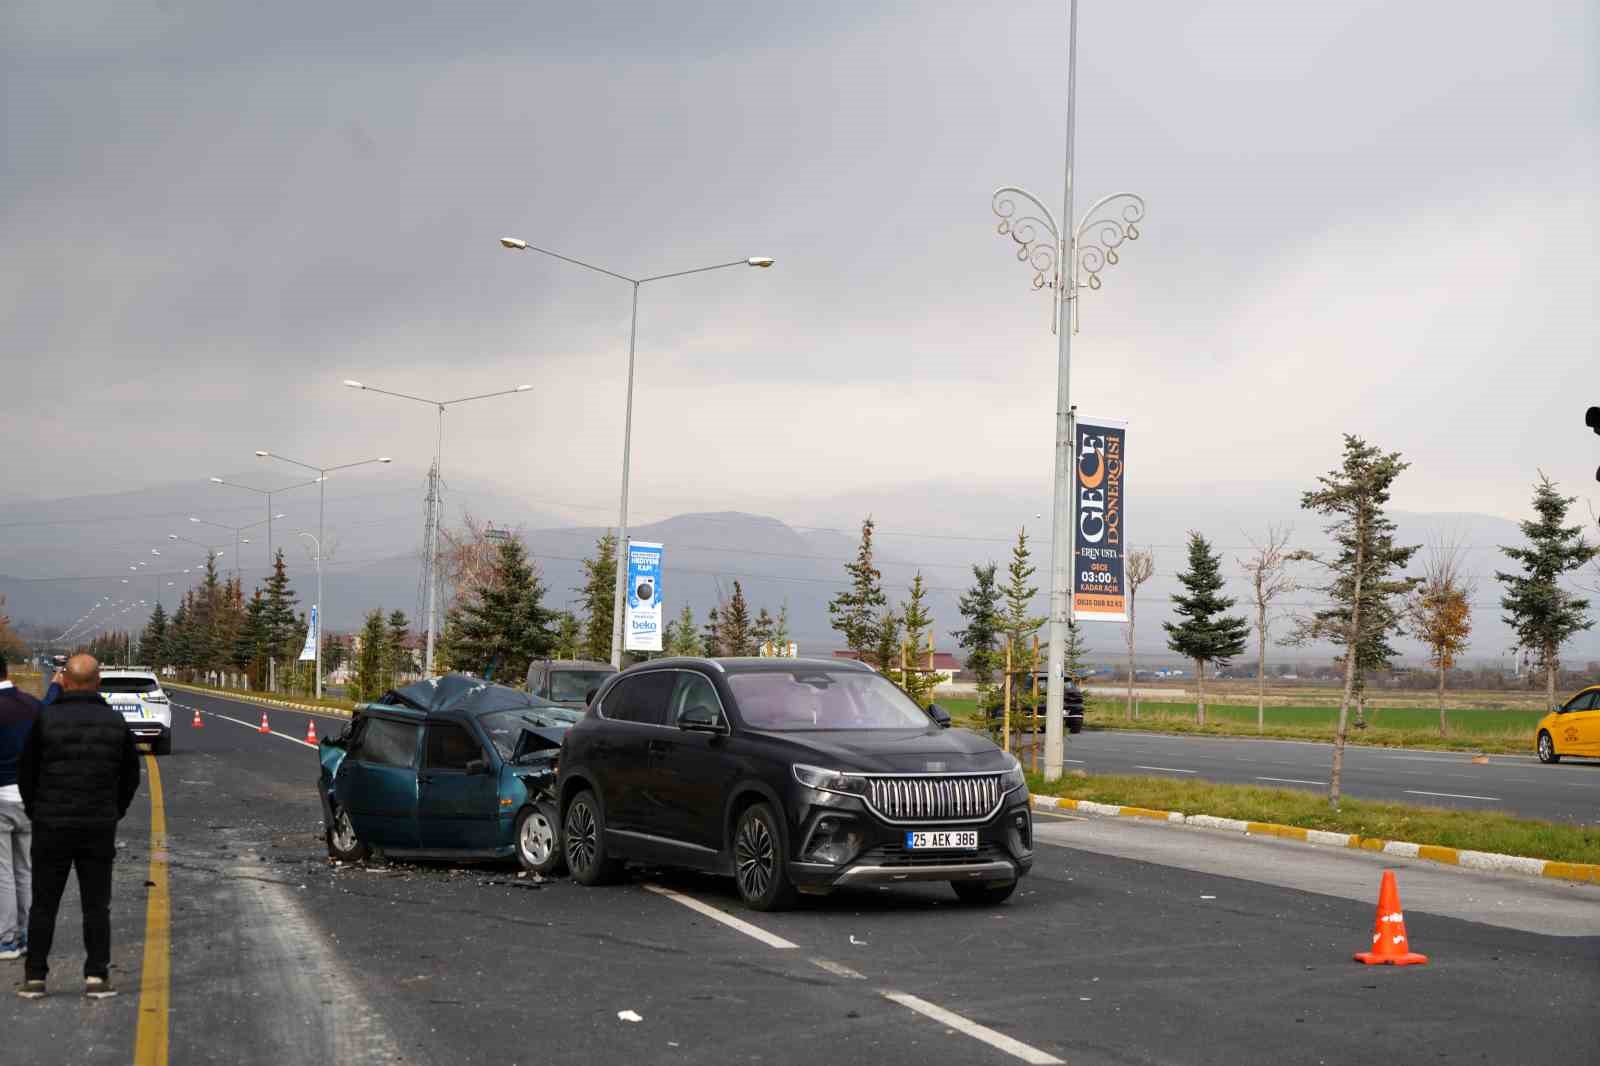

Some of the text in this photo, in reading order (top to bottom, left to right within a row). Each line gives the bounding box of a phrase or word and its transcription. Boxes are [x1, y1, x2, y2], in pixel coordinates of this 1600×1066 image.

[1079, 433, 1105, 543] GECE
[1081, 547, 1117, 560] EREN USTA
[1080, 584, 1103, 592] KADAR
[632, 620, 657, 630] beko
[913, 833, 926, 847] 25
[932, 833, 951, 847] AEK
[955, 833, 975, 846] 386
